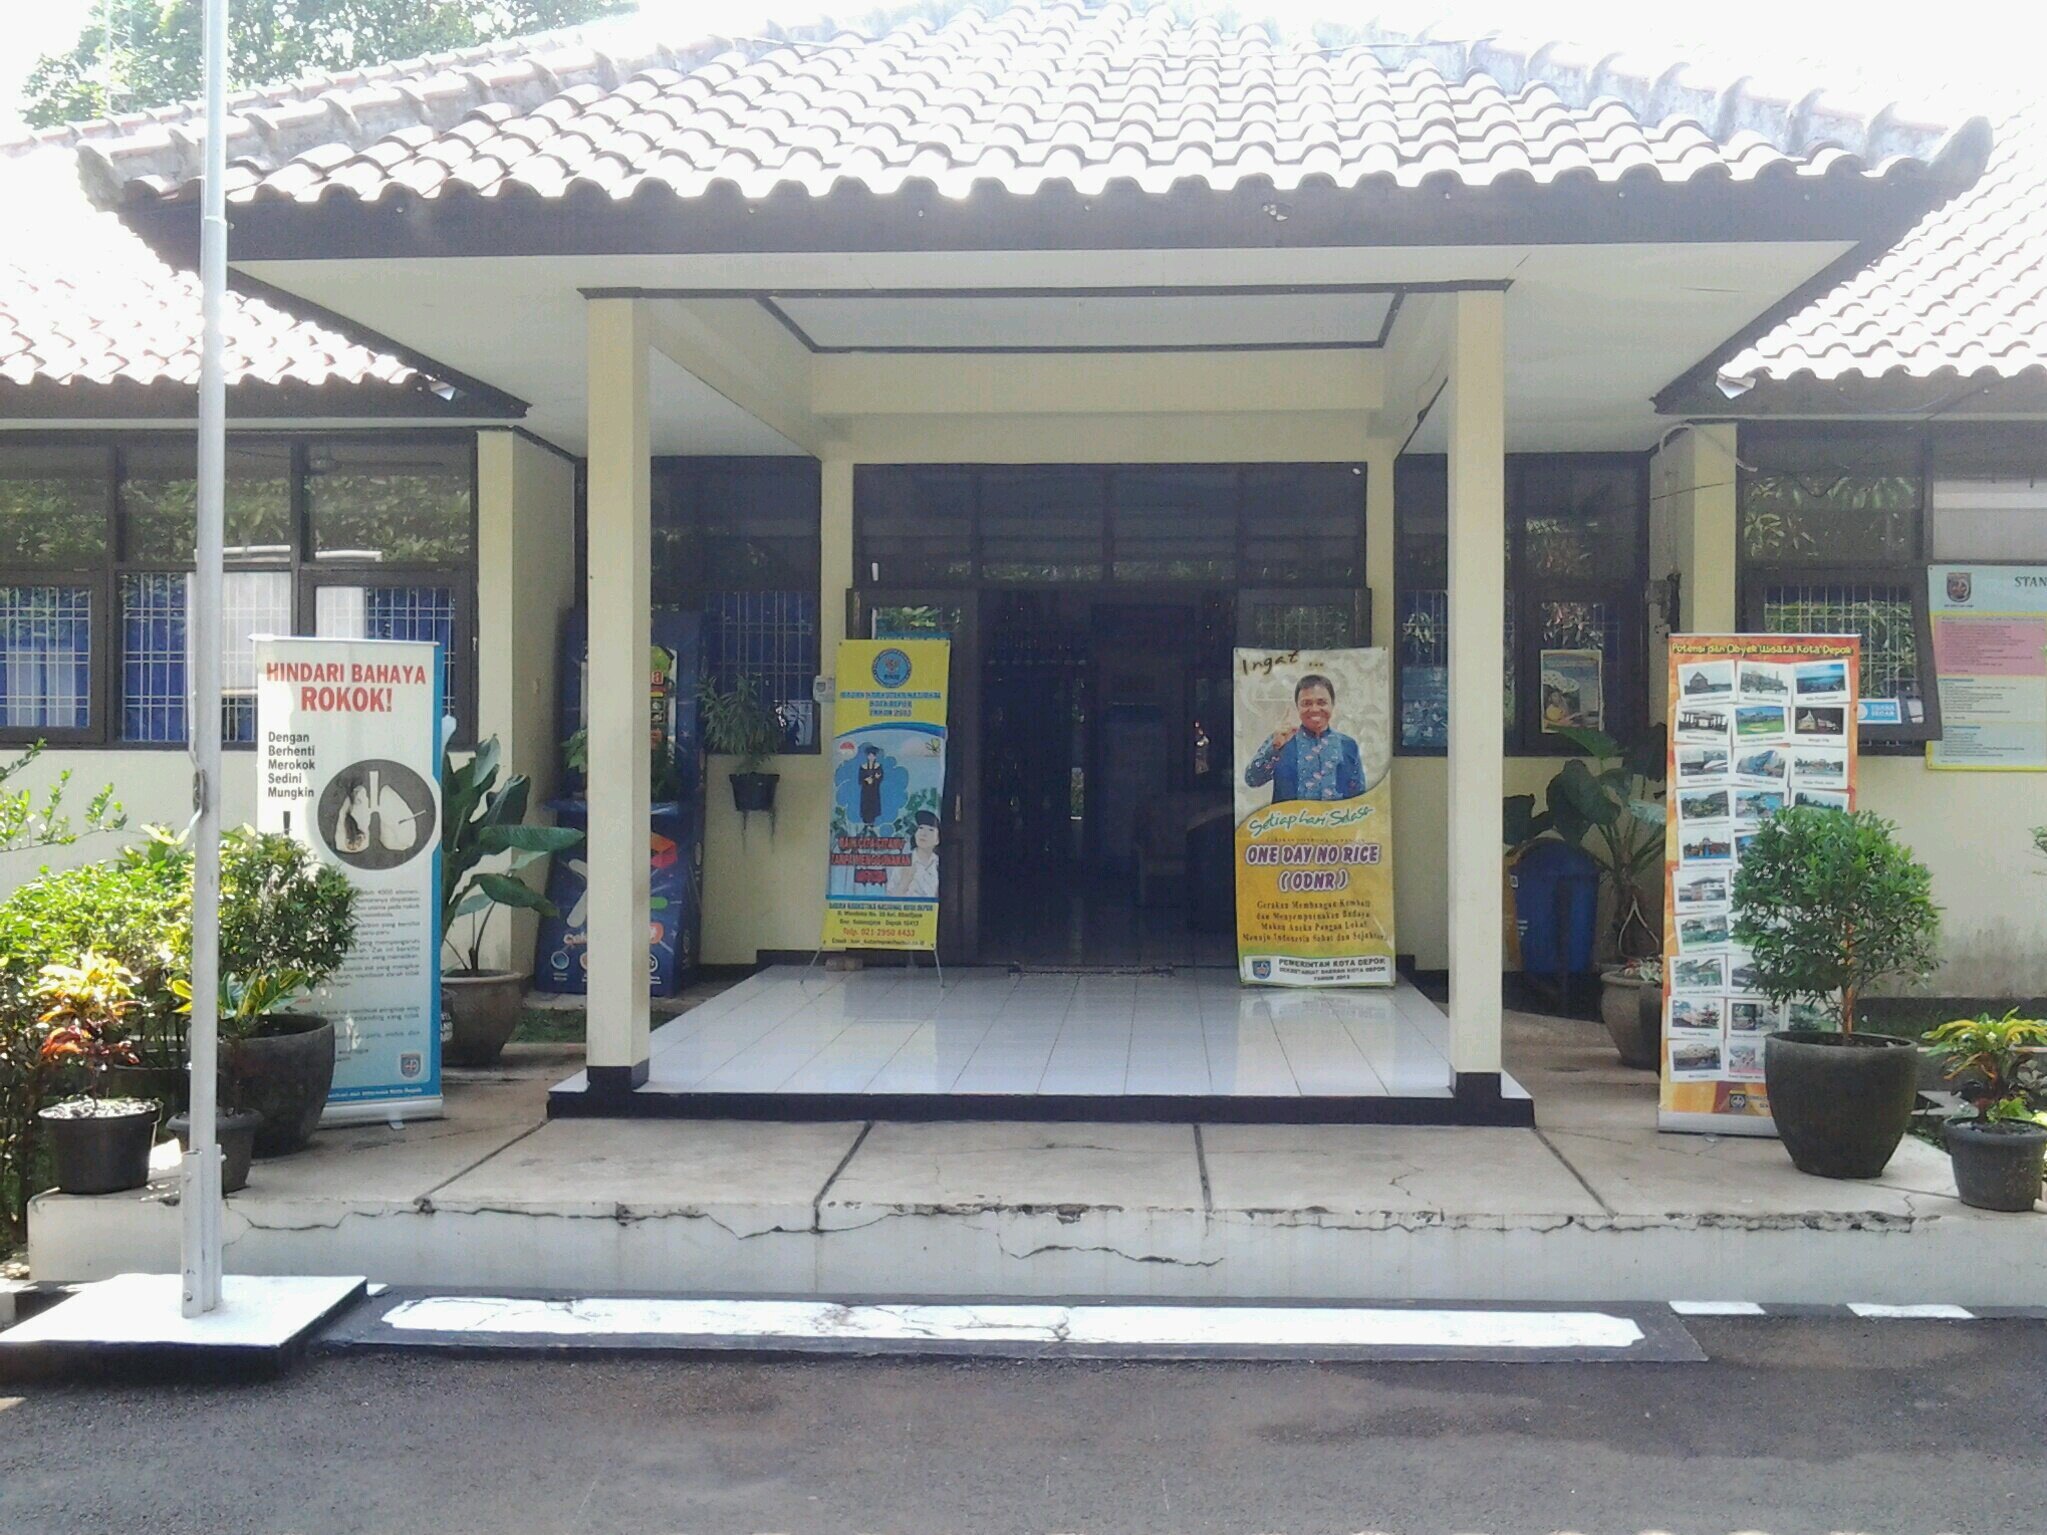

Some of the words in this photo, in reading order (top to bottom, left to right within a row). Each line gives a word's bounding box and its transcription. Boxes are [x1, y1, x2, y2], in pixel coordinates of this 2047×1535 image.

[1759, 644, 1795, 654] Wisata
[1796, 644, 1820, 655] Kota
[1822, 644, 1853, 656] Depok
[1242, 648, 1299, 675] Ingat
[266, 662, 344, 683] HINDARI
[351, 663, 426, 685] BAHAYA
[301, 686, 393, 713] ROKOK!
[268, 731, 310, 745] Dengan
[268, 745, 315, 757] Berhenti
[268, 759, 315, 771] Merokok
[268, 772, 302, 784] Sedini
[268, 786, 315, 801] Mungkin
[1248, 812, 1298, 837] Setiap
[1247, 845, 1279, 864] ONE
[1282, 845, 1313, 864] DAY
[1315, 845, 1339, 864] NO
[1341, 844, 1379, 863] RICE
[1278, 958, 1330, 968] PEMERINTAH
[1332, 959, 1356, 967] KOTA
[1357, 957, 1386, 967] DEPOK
